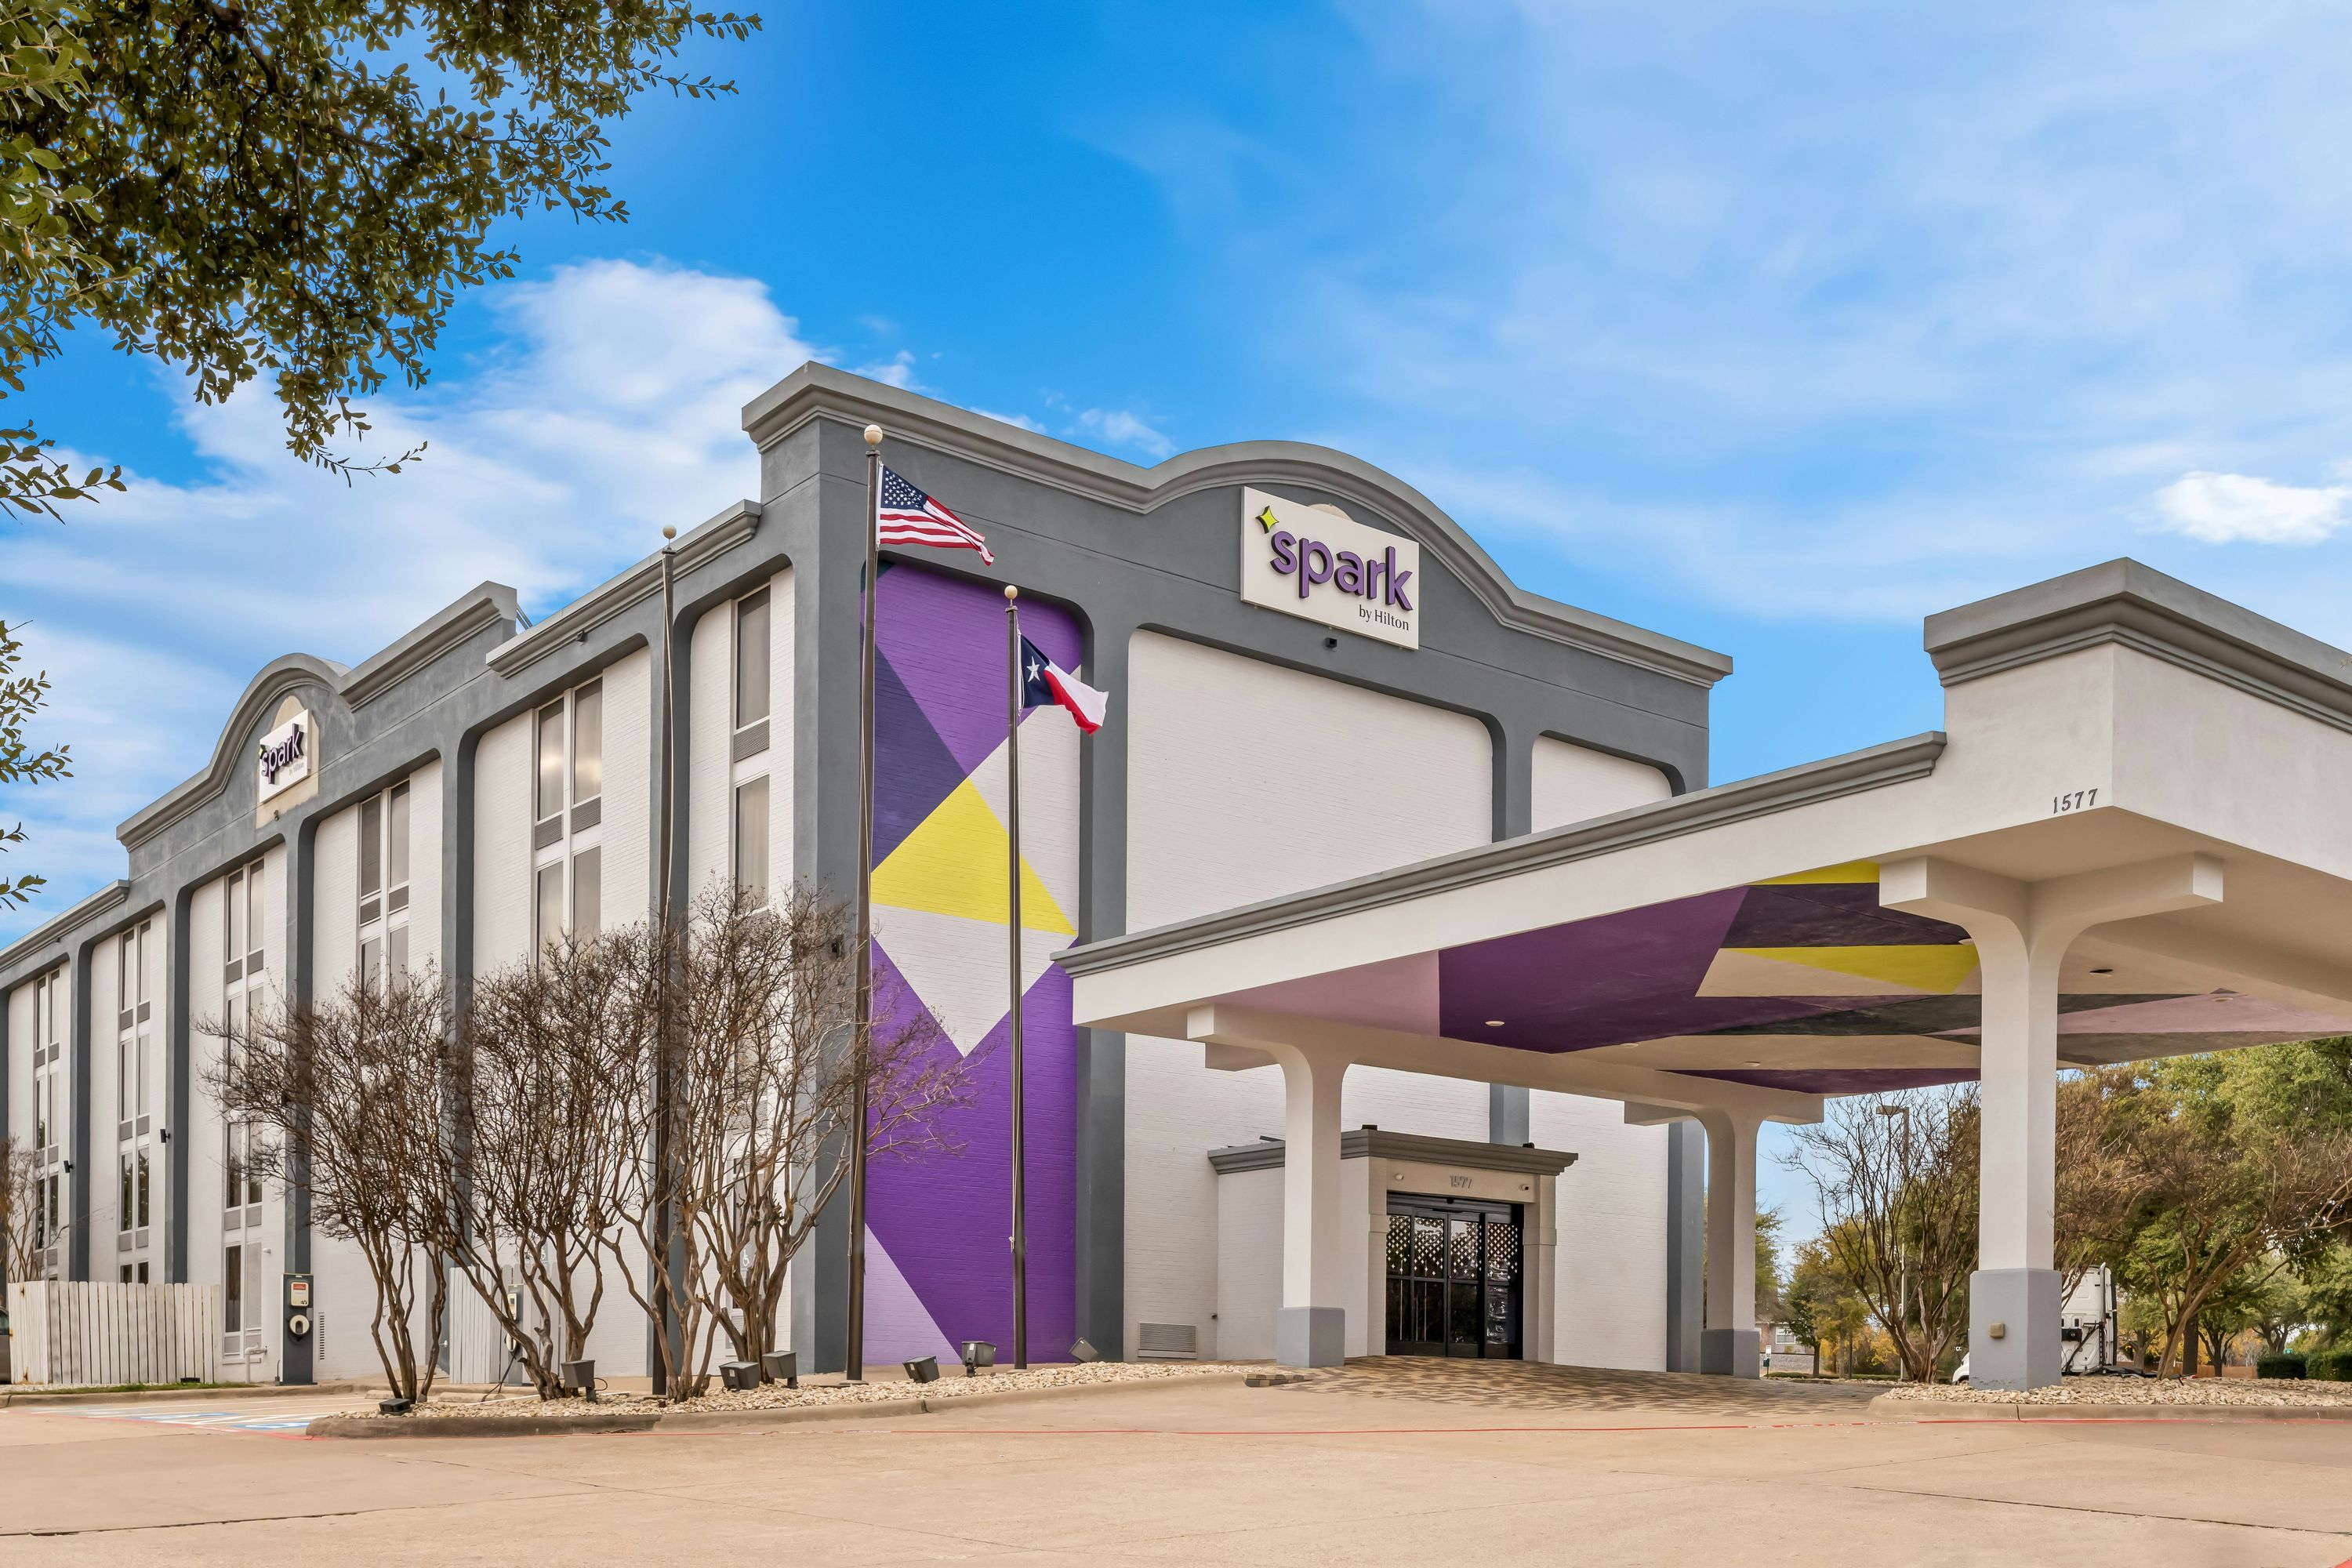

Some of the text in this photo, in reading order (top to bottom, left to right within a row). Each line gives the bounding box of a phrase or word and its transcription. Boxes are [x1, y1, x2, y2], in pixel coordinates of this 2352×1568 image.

[1270, 531, 1413, 612] spark
[1359, 604, 1410, 631] by Hilton
[261, 723, 304, 785] spark
[2053, 788, 2098, 814] 1577
[1450, 1174, 1472, 1189] 1577
